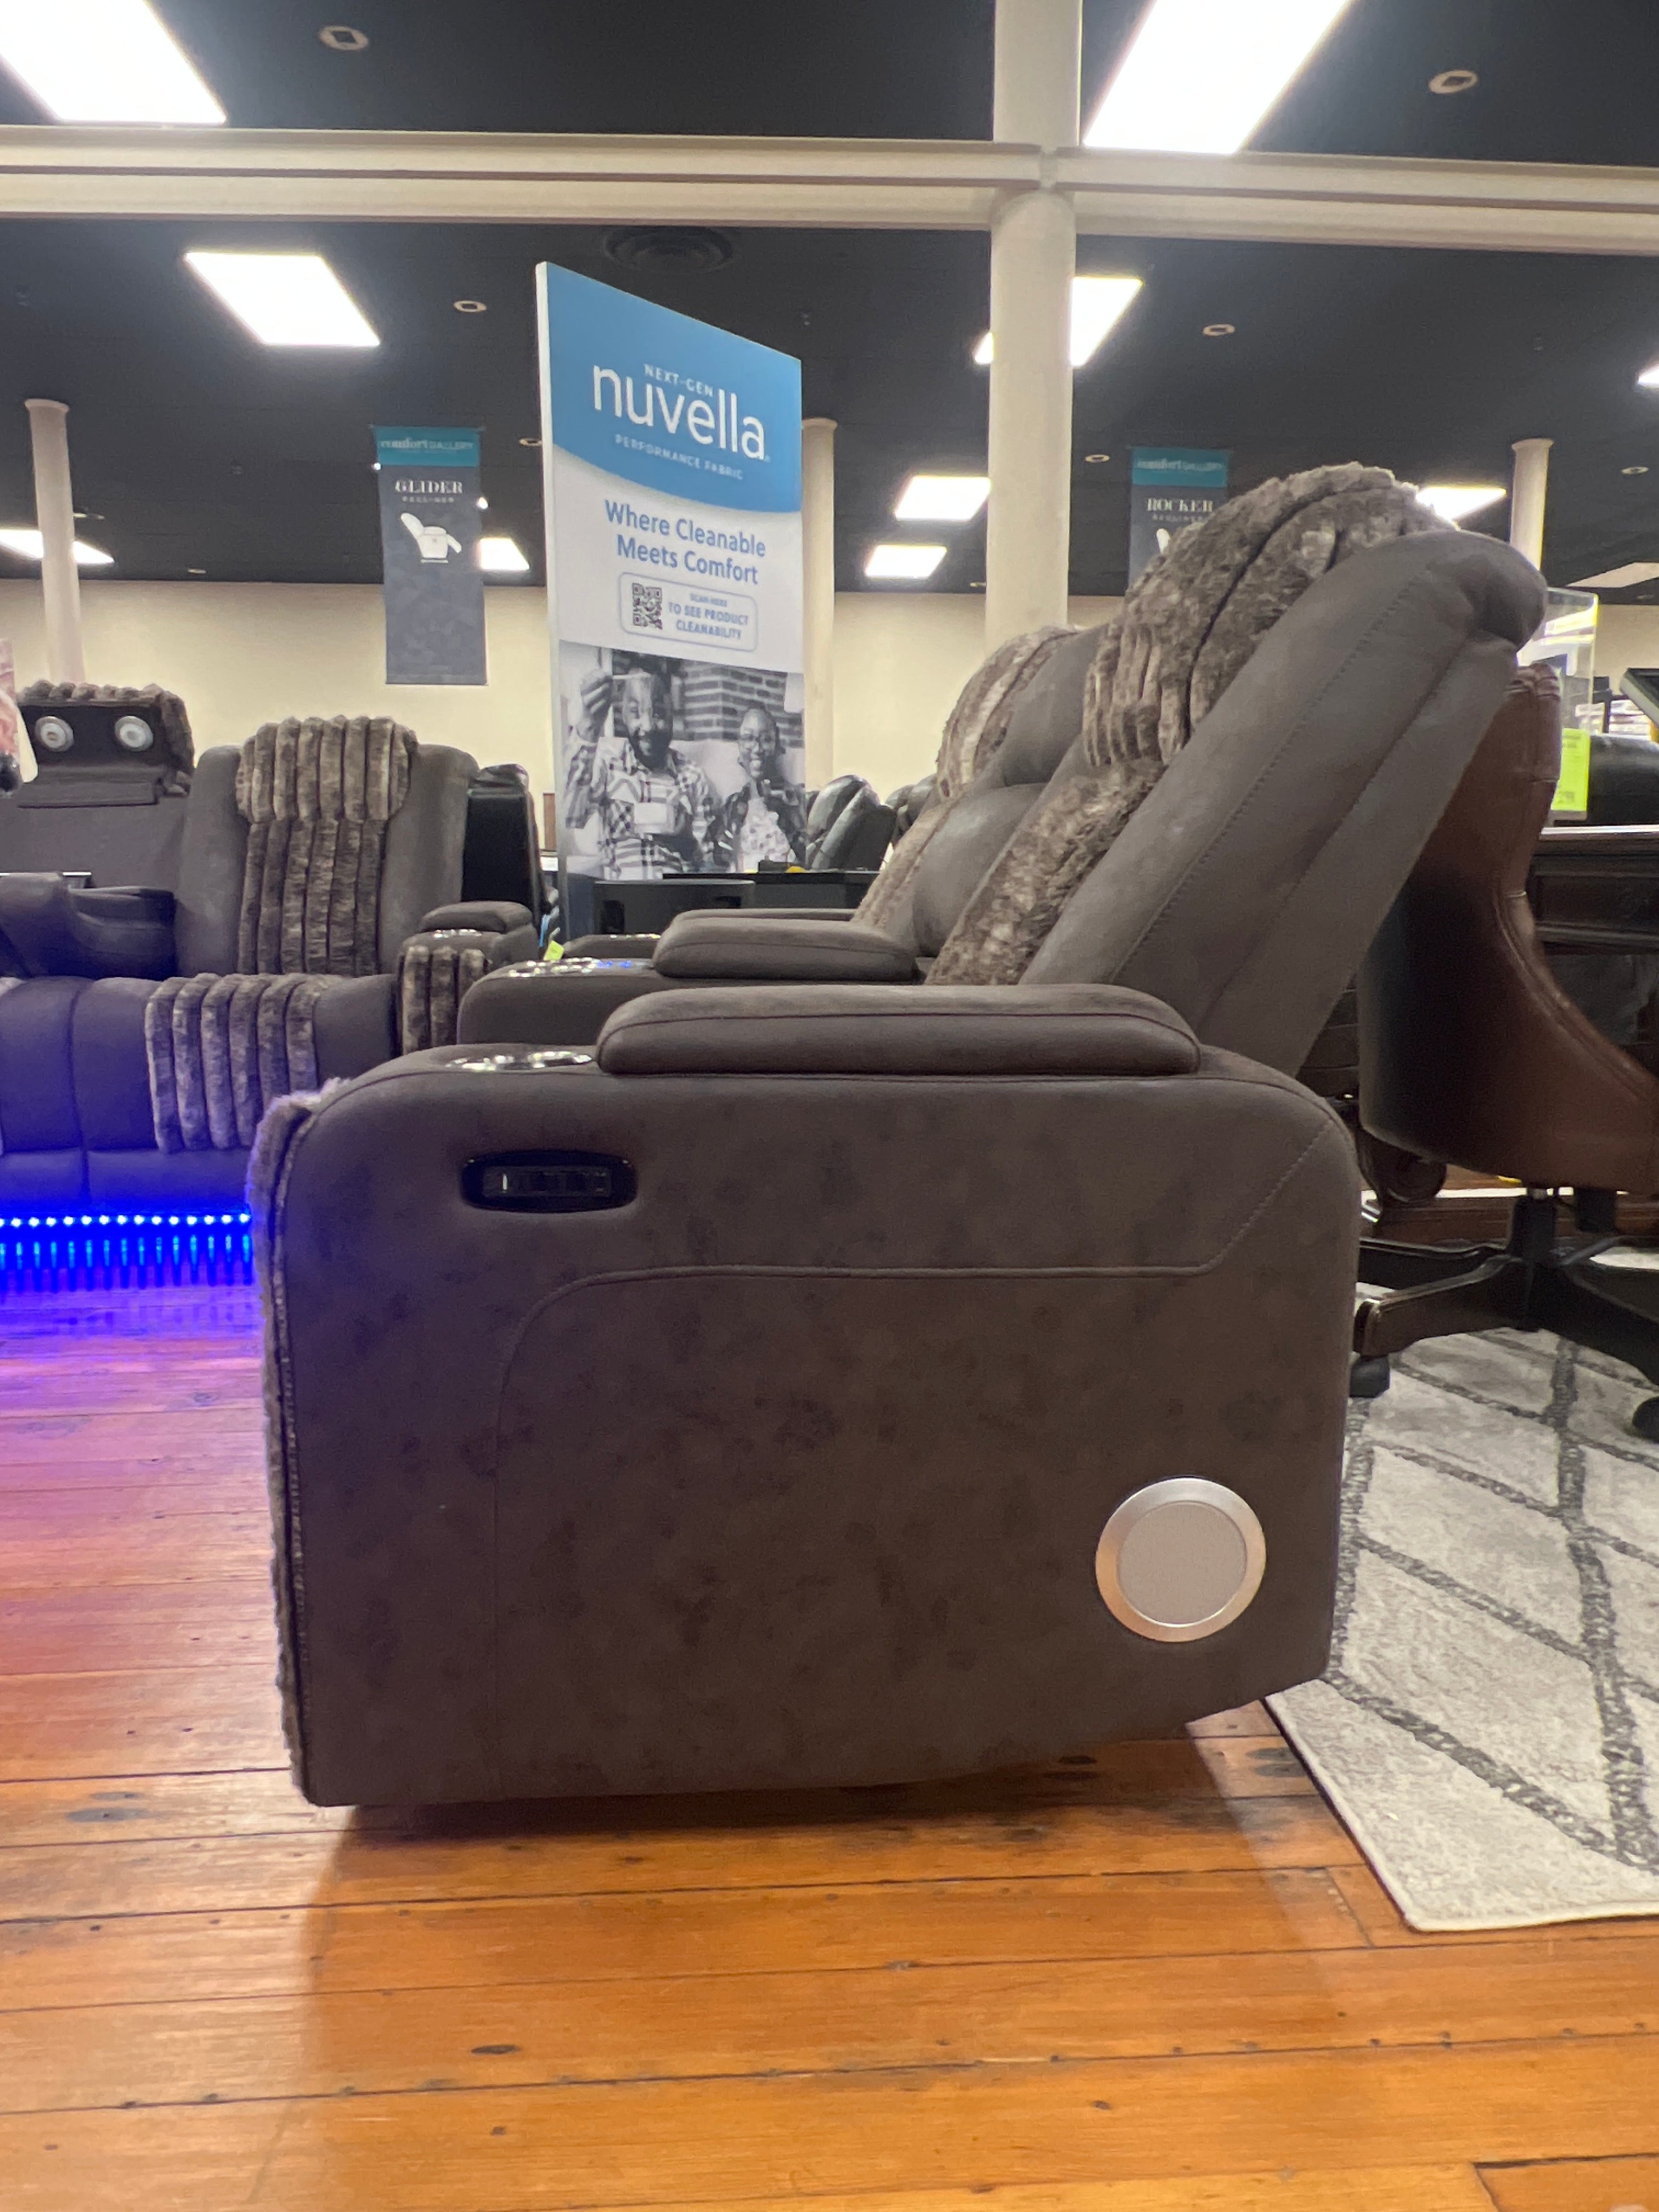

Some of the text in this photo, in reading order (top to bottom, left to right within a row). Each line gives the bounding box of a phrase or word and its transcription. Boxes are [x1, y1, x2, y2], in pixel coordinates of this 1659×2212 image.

[644, 364, 713, 398] NEXT-GEN
[593, 364, 765, 461] nuvella
[615, 434, 744, 481] PERFORMANCE FABRIC
[395, 480, 463, 494] GLIDER
[605, 499, 766, 557] Where Cleanable
[617, 534, 758, 585] Meets Comfort
[668, 602, 681, 614] TO
[704, 608, 749, 625] PRODUCT
